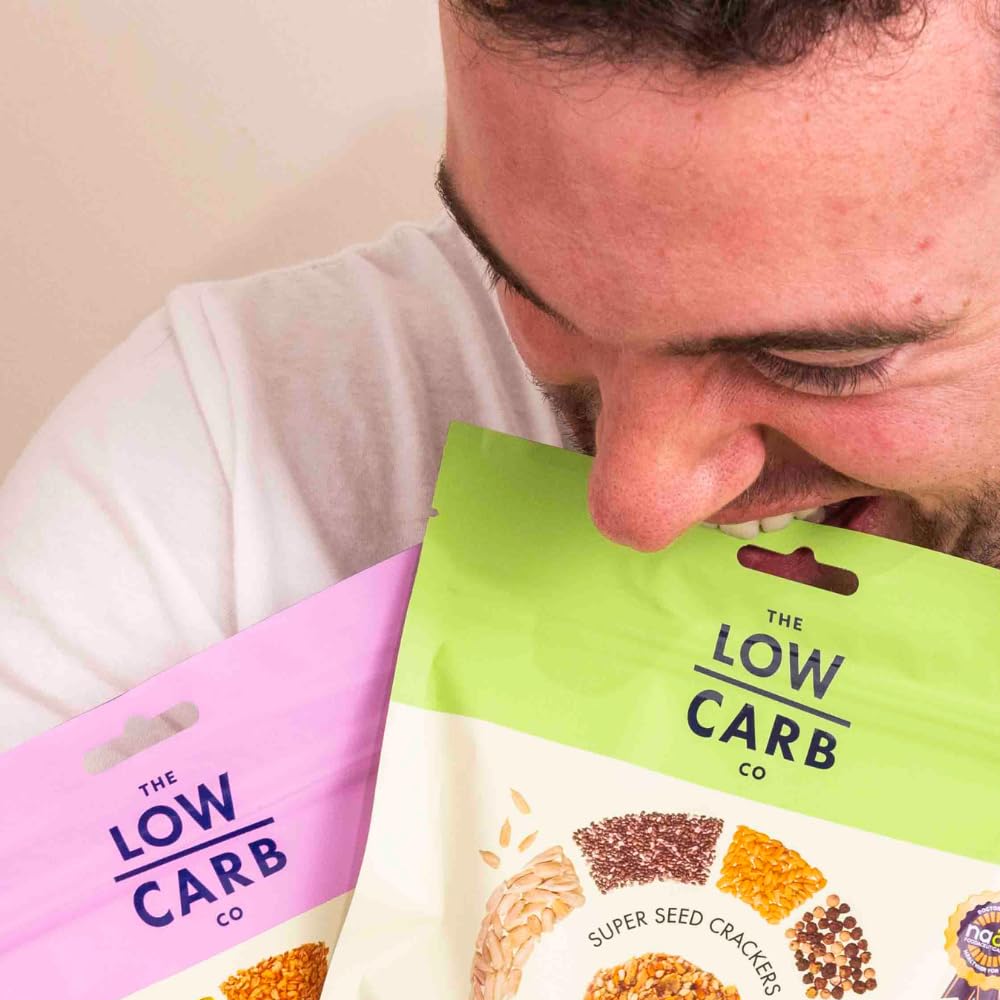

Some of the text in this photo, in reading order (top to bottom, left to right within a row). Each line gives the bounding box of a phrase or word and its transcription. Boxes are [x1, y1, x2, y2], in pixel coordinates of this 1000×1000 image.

[767, 609, 803, 631] THE
[713, 623, 845, 700] LOW
[687, 689, 837, 770] CARB
[138, 770, 178, 797] THE
[738, 762, 766, 780] CO
[109, 772, 236, 861] LOW
[133, 837, 288, 928] CARB
[216, 906, 243, 927] CO
[588, 907, 781, 997] SUPER SEED CRACKERS
